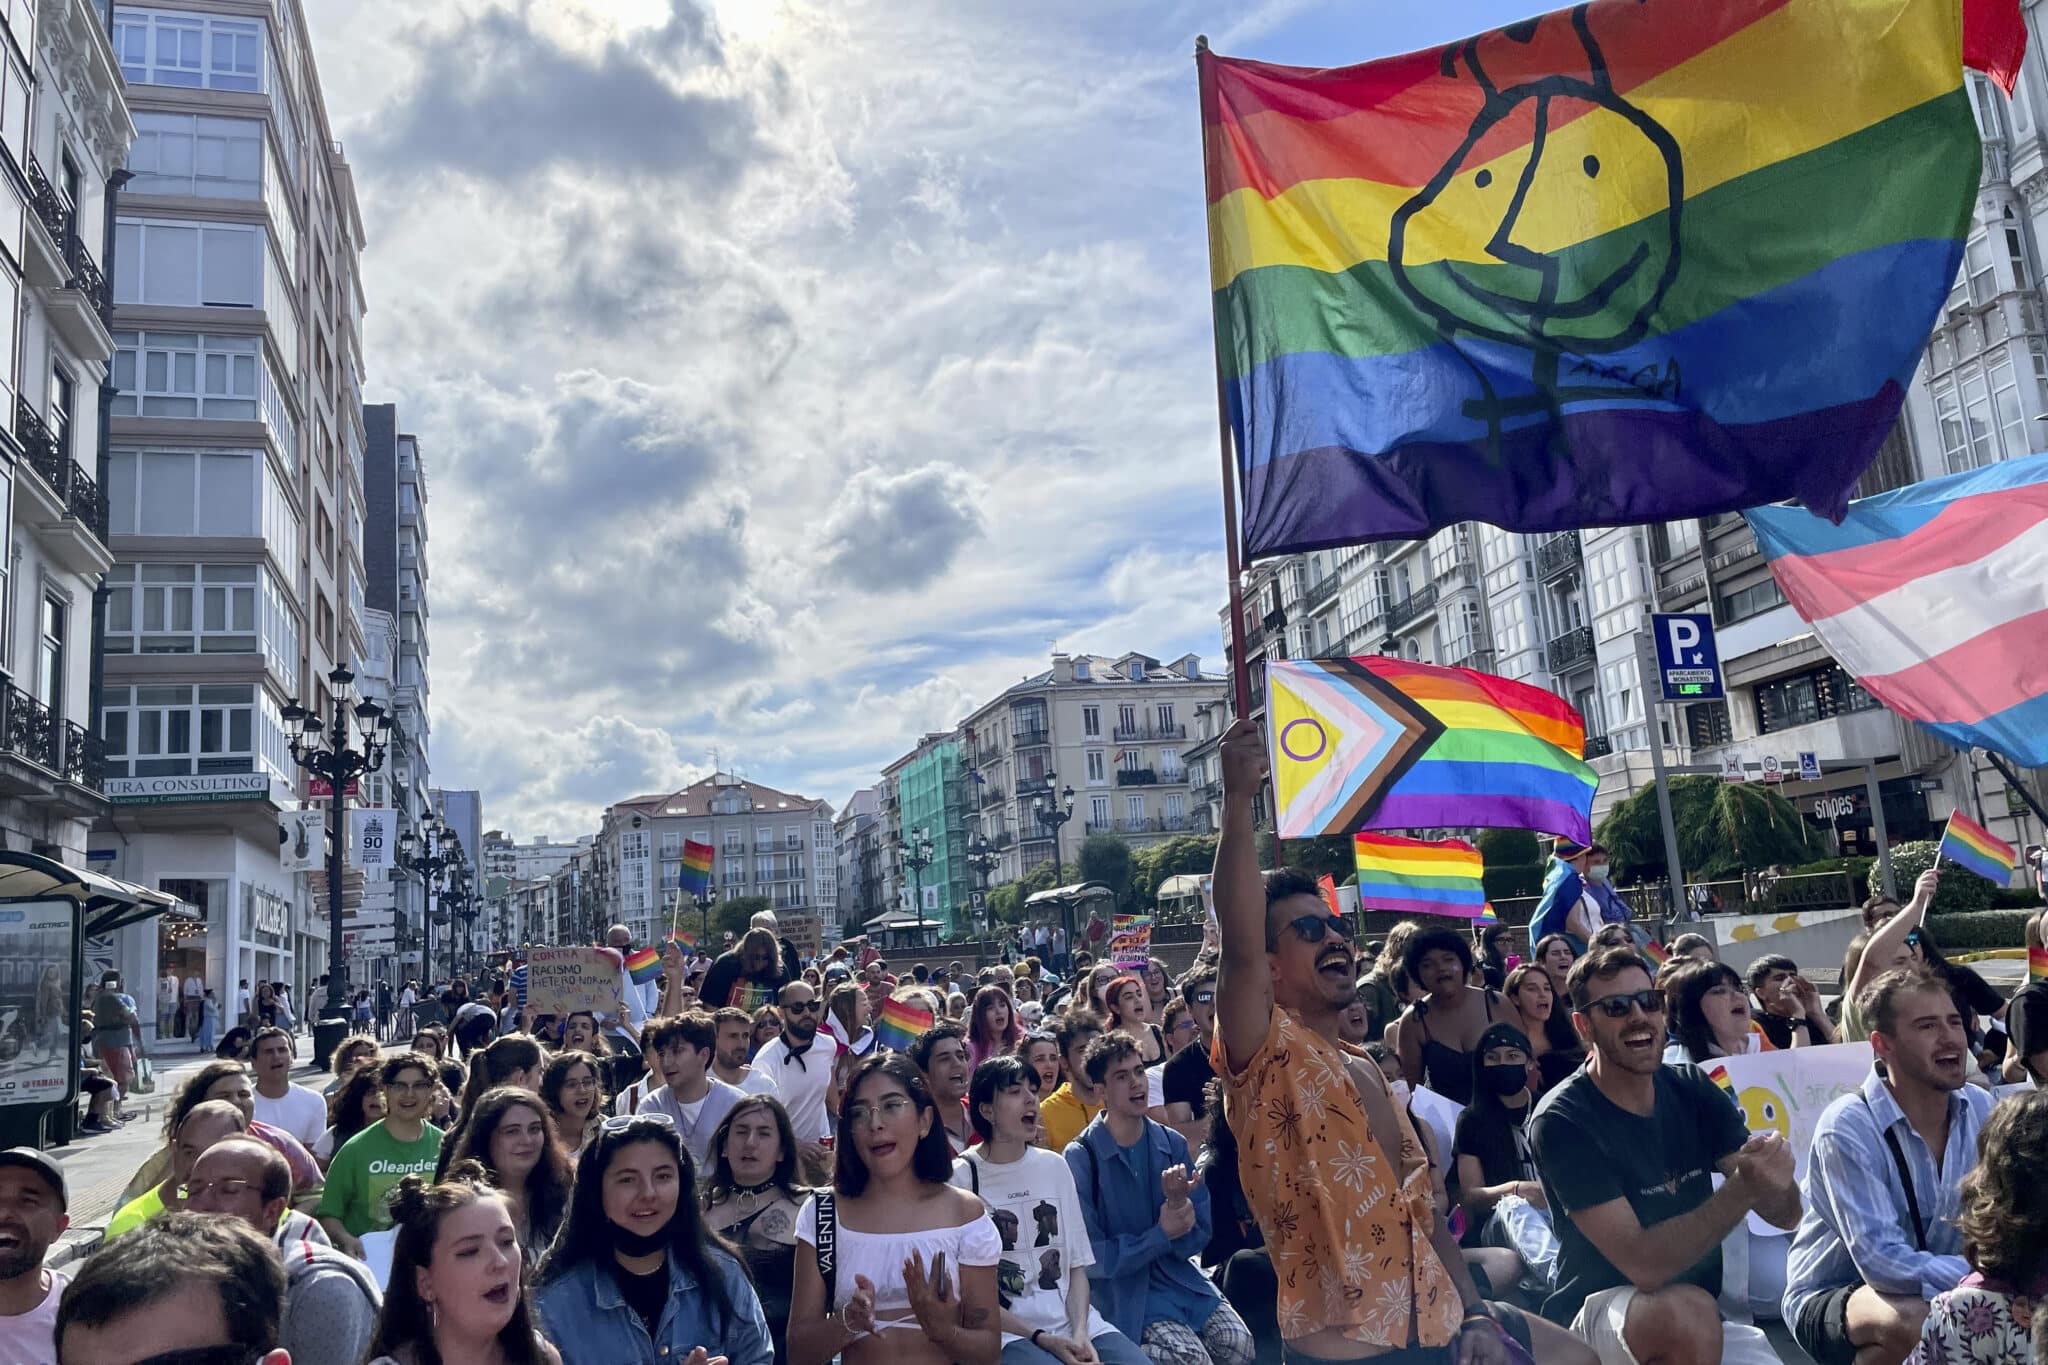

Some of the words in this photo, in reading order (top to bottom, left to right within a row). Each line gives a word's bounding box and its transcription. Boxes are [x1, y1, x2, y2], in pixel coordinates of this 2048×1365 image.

[1668, 618, 1700, 665] P
[1679, 684, 1704, 694] LIBRE
[105, 780, 146, 794] URA
[152, 776, 262, 792] CONSULTING
[212, 791, 262, 801] Empresarial
[1814, 794, 1853, 820] snipes
[363, 837, 383, 849] 90
[972, 893, 981, 908] P
[532, 949, 578, 961] CONTRA
[531, 964, 582, 977] RACISMO
[31, 1078, 65, 1088] YAMAHA
[368, 1158, 438, 1174] Oleander
